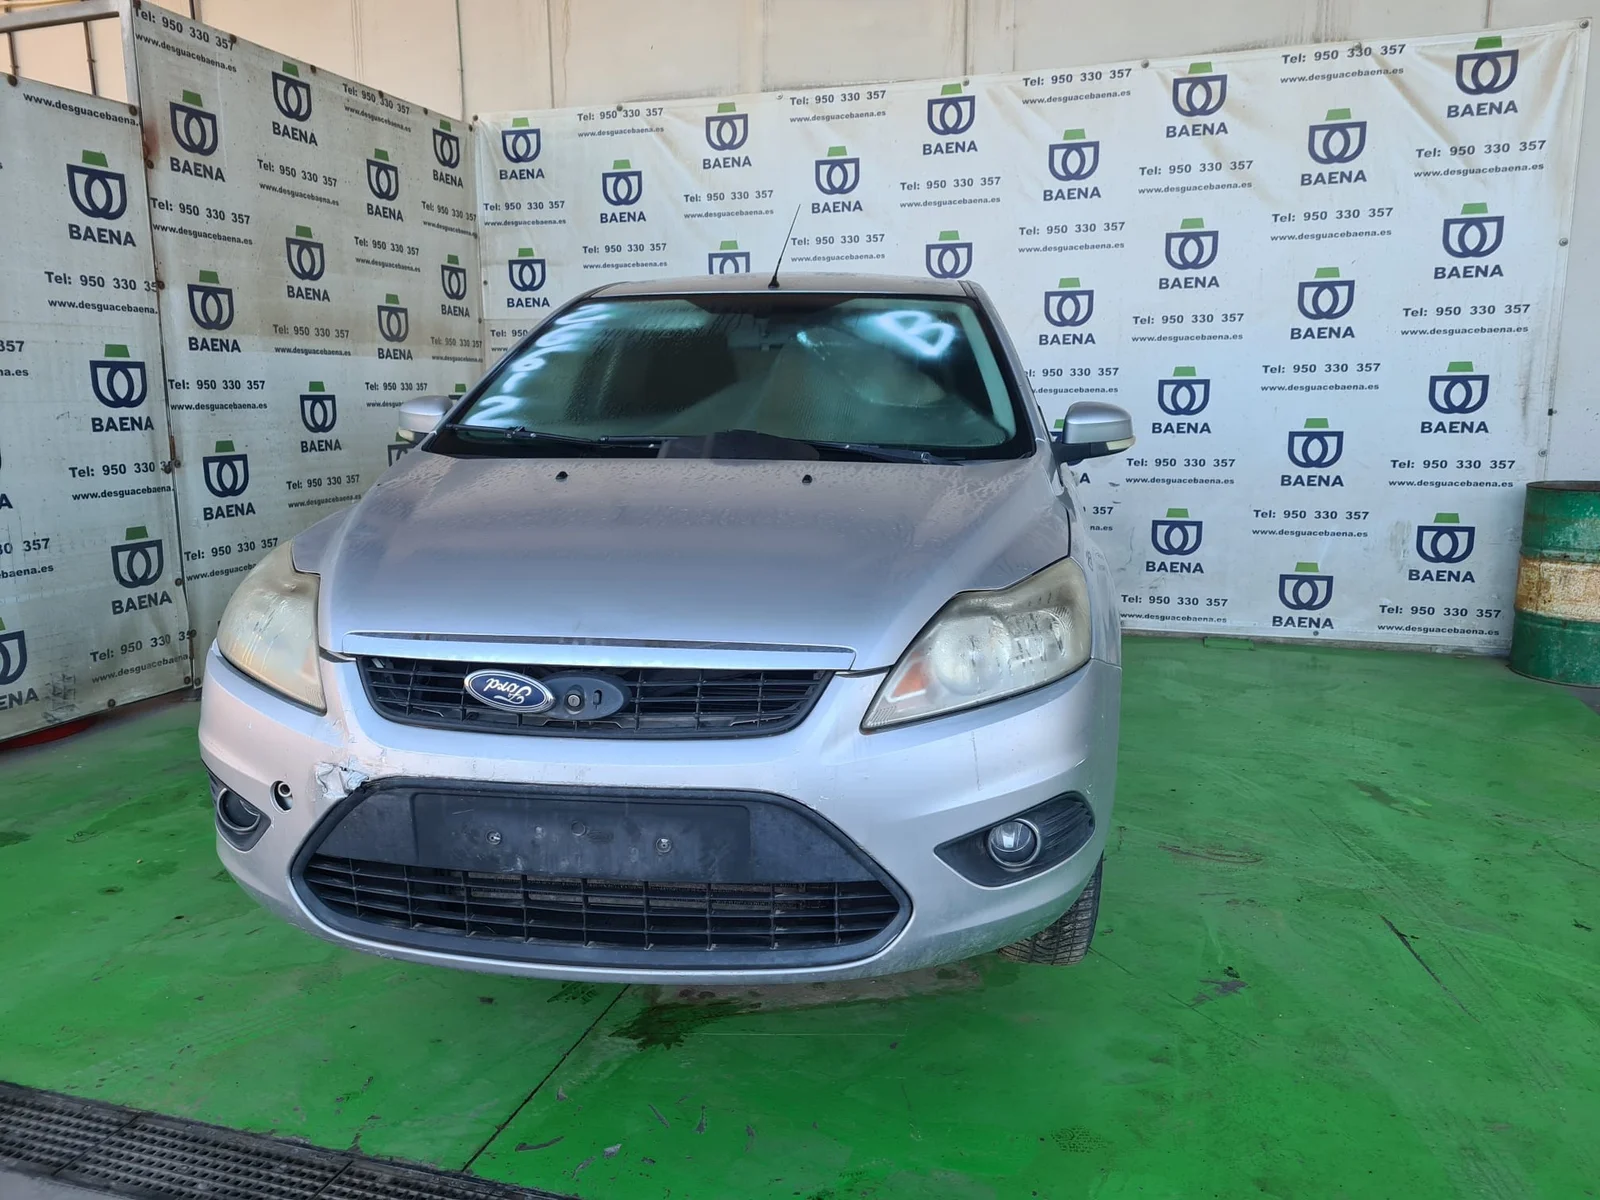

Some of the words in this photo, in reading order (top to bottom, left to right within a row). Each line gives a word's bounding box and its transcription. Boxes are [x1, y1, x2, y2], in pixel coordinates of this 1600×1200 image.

[134, 8, 155, 23] Tel:
[162, 17, 182, 33] 950
[190, 26, 209, 42] 330
[216, 36, 234, 51] 357
[136, 33, 236, 72] www.desguacebaena.es
[1282, 54, 1306, 64] Tel:
[1314, 50, 1338, 61] 950
[1347, 46, 1372, 58] 330
[1380, 44, 1406, 55] 357
[1023, 77, 1044, 86] Tel:
[1051, 74, 1072, 84] 950
[1080, 71, 1102, 82] 330
[1110, 68, 1132, 79] 357
[1280, 68, 1404, 83] www.desguacebaena.es
[1022, 91, 1130, 104] www.desguacebaena.es
[23, 92, 139, 126] www.desguacebaena.
[577, 112, 594, 121] Tel:
[600, 110, 617, 119] 950
[623, 109, 640, 118] 330
[646, 108, 663, 116] 357
[1447, 100, 1518, 118] BAENA
[790, 111, 886, 122] www.desguacebaena.es
[272, 121, 318, 146] BAENA
[578, 128, 664, 137] www.desguacebaena.es
[1166, 122, 1228, 138] BAENA
[923, 140, 978, 155] BAENA
[1416, 148, 1440, 158] Tel:
[1450, 146, 1475, 156] 950
[1484, 143, 1510, 154] 330
[1519, 140, 1546, 151] 357
[703, 156, 752, 169] BAENA
[1139, 166, 1161, 176] Tel:
[1169, 164, 1191, 174] 950
[1200, 162, 1222, 172] 330
[1230, 160, 1253, 170] 357
[170, 157, 225, 182] BAENA
[257, 159, 274, 172] Tel:
[280, 165, 296, 178] 950
[302, 170, 318, 182] 330
[323, 176, 337, 187] 357
[500, 168, 544, 180] BAENA
[1414, 164, 1544, 177] www.desguacebaena.es
[433, 169, 464, 188] BAENA
[900, 182, 920, 190] Tel:
[926, 180, 946, 189] 950
[954, 178, 973, 187] 330
[981, 176, 1000, 186] 357
[1301, 170, 1366, 186] BAENA
[1044, 187, 1101, 201] BAENA
[1138, 182, 1252, 194] www.desguacebaena.es
[684, 194, 701, 202] Tel:
[707, 192, 724, 201] 950
[731, 191, 749, 200] 330
[756, 190, 773, 198] 357
[812, 200, 862, 214] BAENA
[900, 198, 1000, 208] www.desguacebaena.es
[151, 198, 172, 211] Tel:
[179, 203, 199, 216] 950
[206, 208, 225, 220] 330
[232, 213, 250, 224] 357
[367, 203, 403, 222] BAENA
[600, 212, 646, 223] BAENA
[684, 210, 774, 218] www.desguacebaena.es
[152, 223, 252, 245] www.desguacebaena.es
[1019, 226, 1039, 235] Tel:
[1047, 225, 1068, 234] 950
[1075, 224, 1096, 232] 330
[1104, 222, 1125, 231] 357
[68, 224, 136, 247] BAENA
[1271, 230, 1391, 241] www.desguacebaena.es
[354, 236, 368, 247] Tel:
[372, 240, 386, 250] 950
[391, 243, 404, 253] 330
[407, 246, 419, 256] 357
[1018, 243, 1124, 252] www.desguacebaena.es
[1434, 264, 1503, 279] BAENA
[44, 271, 71, 285] Tel:
[80, 275, 104, 288] 950
[113, 278, 136, 290] 330
[144, 280, 157, 292] 35
[1159, 276, 1219, 289] BAENA
[287, 285, 330, 302] BAENA
[48, 299, 158, 314] www.desguacebaena.
[507, 298, 550, 308] BAENA
[441, 304, 470, 317] BAENA
[1403, 308, 1427, 316] Tel:
[1436, 306, 1461, 316] 950
[1470, 305, 1495, 315] 330
[1505, 304, 1530, 314] 357
[1133, 316, 1154, 324] Tel:
[1162, 315, 1184, 324] 950
[1192, 314, 1214, 323] 330
[1222, 313, 1244, 322] 357
[1132, 334, 1243, 342] www.desguacebaena.es
[1290, 326, 1355, 339] BAENA
[1401, 327, 1528, 336] www.desguacebaena.es
[188, 337, 241, 352] BAENA
[1039, 333, 1096, 345] BAENA
[378, 348, 413, 360] BAENA
[1262, 365, 1285, 373] Tel:
[1293, 364, 1316, 373] 950
[1325, 364, 1348, 372] 330
[1357, 363, 1380, 372] 357
[168, 379, 189, 389] Tel:
[197, 380, 216, 390] 950
[222, 380, 240, 390] 330
[247, 380, 265, 390] 357
[1033, 387, 1119, 395] .desguacebaena.es
[1261, 384, 1379, 392] www.desguacebaena.es
[170, 402, 267, 412] www.desguacebaena.es
[92, 416, 154, 432] BAENA
[1152, 423, 1211, 434] BAENA
[1421, 421, 1488, 433] BAENA
[301, 439, 342, 452] BAENA
[1126, 458, 1147, 466] Tel:
[1155, 458, 1176, 466] 950
[1184, 459, 1205, 467] 330
[1214, 459, 1235, 467] 357
[1391, 460, 1414, 468] Tel:
[1423, 460, 1447, 468] 950
[1456, 460, 1481, 468] 330
[1490, 460, 1515, 469] 357
[69, 466, 94, 478] Tel:
[102, 464, 126, 475] 950
[134, 462, 155, 473] 330
[286, 480, 302, 490] Tel:
[307, 478, 322, 488] 950
[327, 476, 341, 486] 330
[346, 474, 360, 484] 357
[1126, 477, 1234, 485] www.desguacebaena.es
[1281, 475, 1344, 486] BAENA
[1389, 480, 1513, 488] www.desguacebaena.es
[72, 485, 174, 500] www.desguacebaena.
[204, 502, 256, 520] BAENA
[1093, 507, 1113, 515] 357
[1252, 529, 1368, 537] www.desguacebaena.es
[23, 538, 50, 552] 357
[184, 550, 204, 561] Tel:
[212, 545, 231, 557] 950
[238, 541, 256, 552] 330
[261, 538, 278, 548] 357
[186, 563, 256, 581] www.desguaceba
[1146, 561, 1204, 573] BAENA
[1408, 570, 1475, 583] BAENA
[112, 591, 172, 615] BAENA
[1119, 612, 1226, 622] www.desguacebaena.es
[1380, 605, 1402, 614] Tel:
[1411, 606, 1435, 615] 950
[1444, 608, 1468, 616] 330
[1476, 609, 1501, 619] 357
[1272, 616, 1334, 629] BAENA
[1377, 623, 1499, 636] www.desguacebaena.es
[483, 677, 532, 705] Ford
[0, 688, 39, 711] ENA
